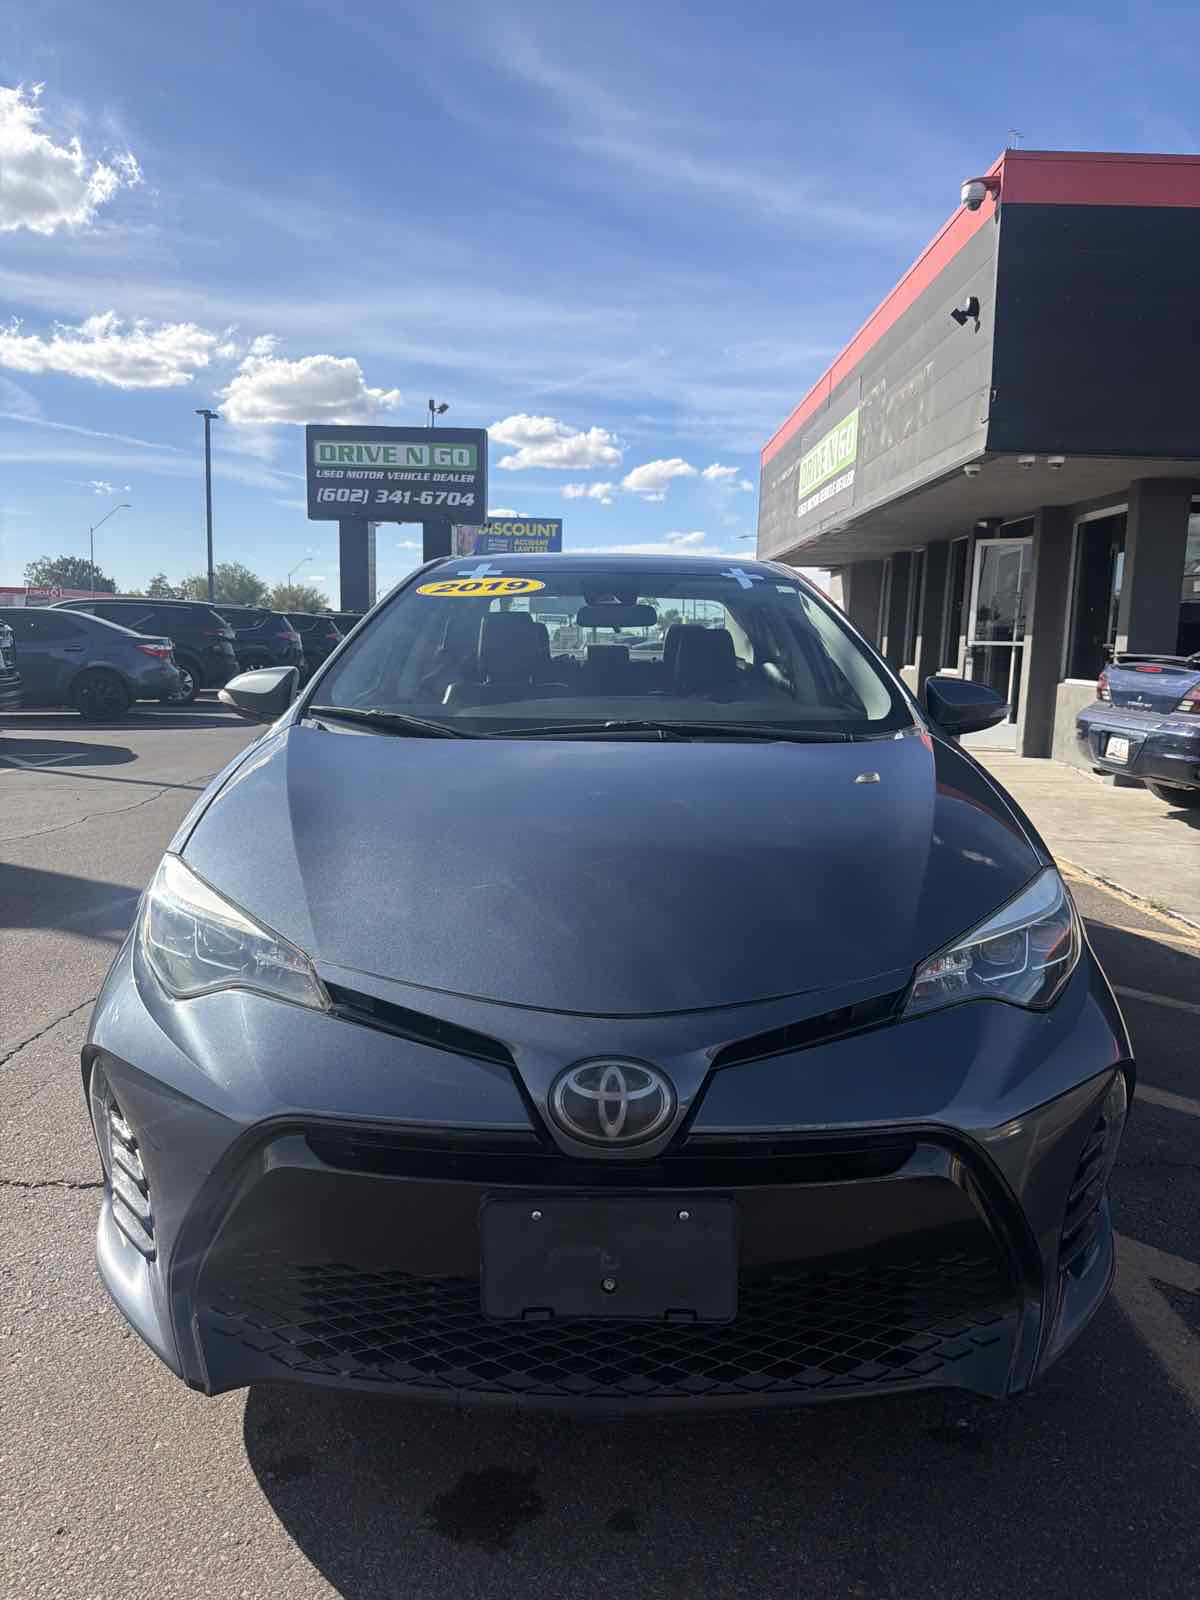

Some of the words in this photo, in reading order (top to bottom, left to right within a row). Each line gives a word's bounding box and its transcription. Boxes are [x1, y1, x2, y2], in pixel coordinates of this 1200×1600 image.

[319, 444, 398, 464] DRIVE
[406, 446, 424, 465] N
[434, 448, 470, 466] GO
[316, 469, 344, 479] USED
[346, 470, 385, 481] MOTOR
[387, 471, 431, 482] VEHICLE
[432, 473, 475, 484] DEALER
[317, 488, 369, 504] (602)
[375, 489, 475, 507] 341-6704
[430, 581, 529, 593] 2019
